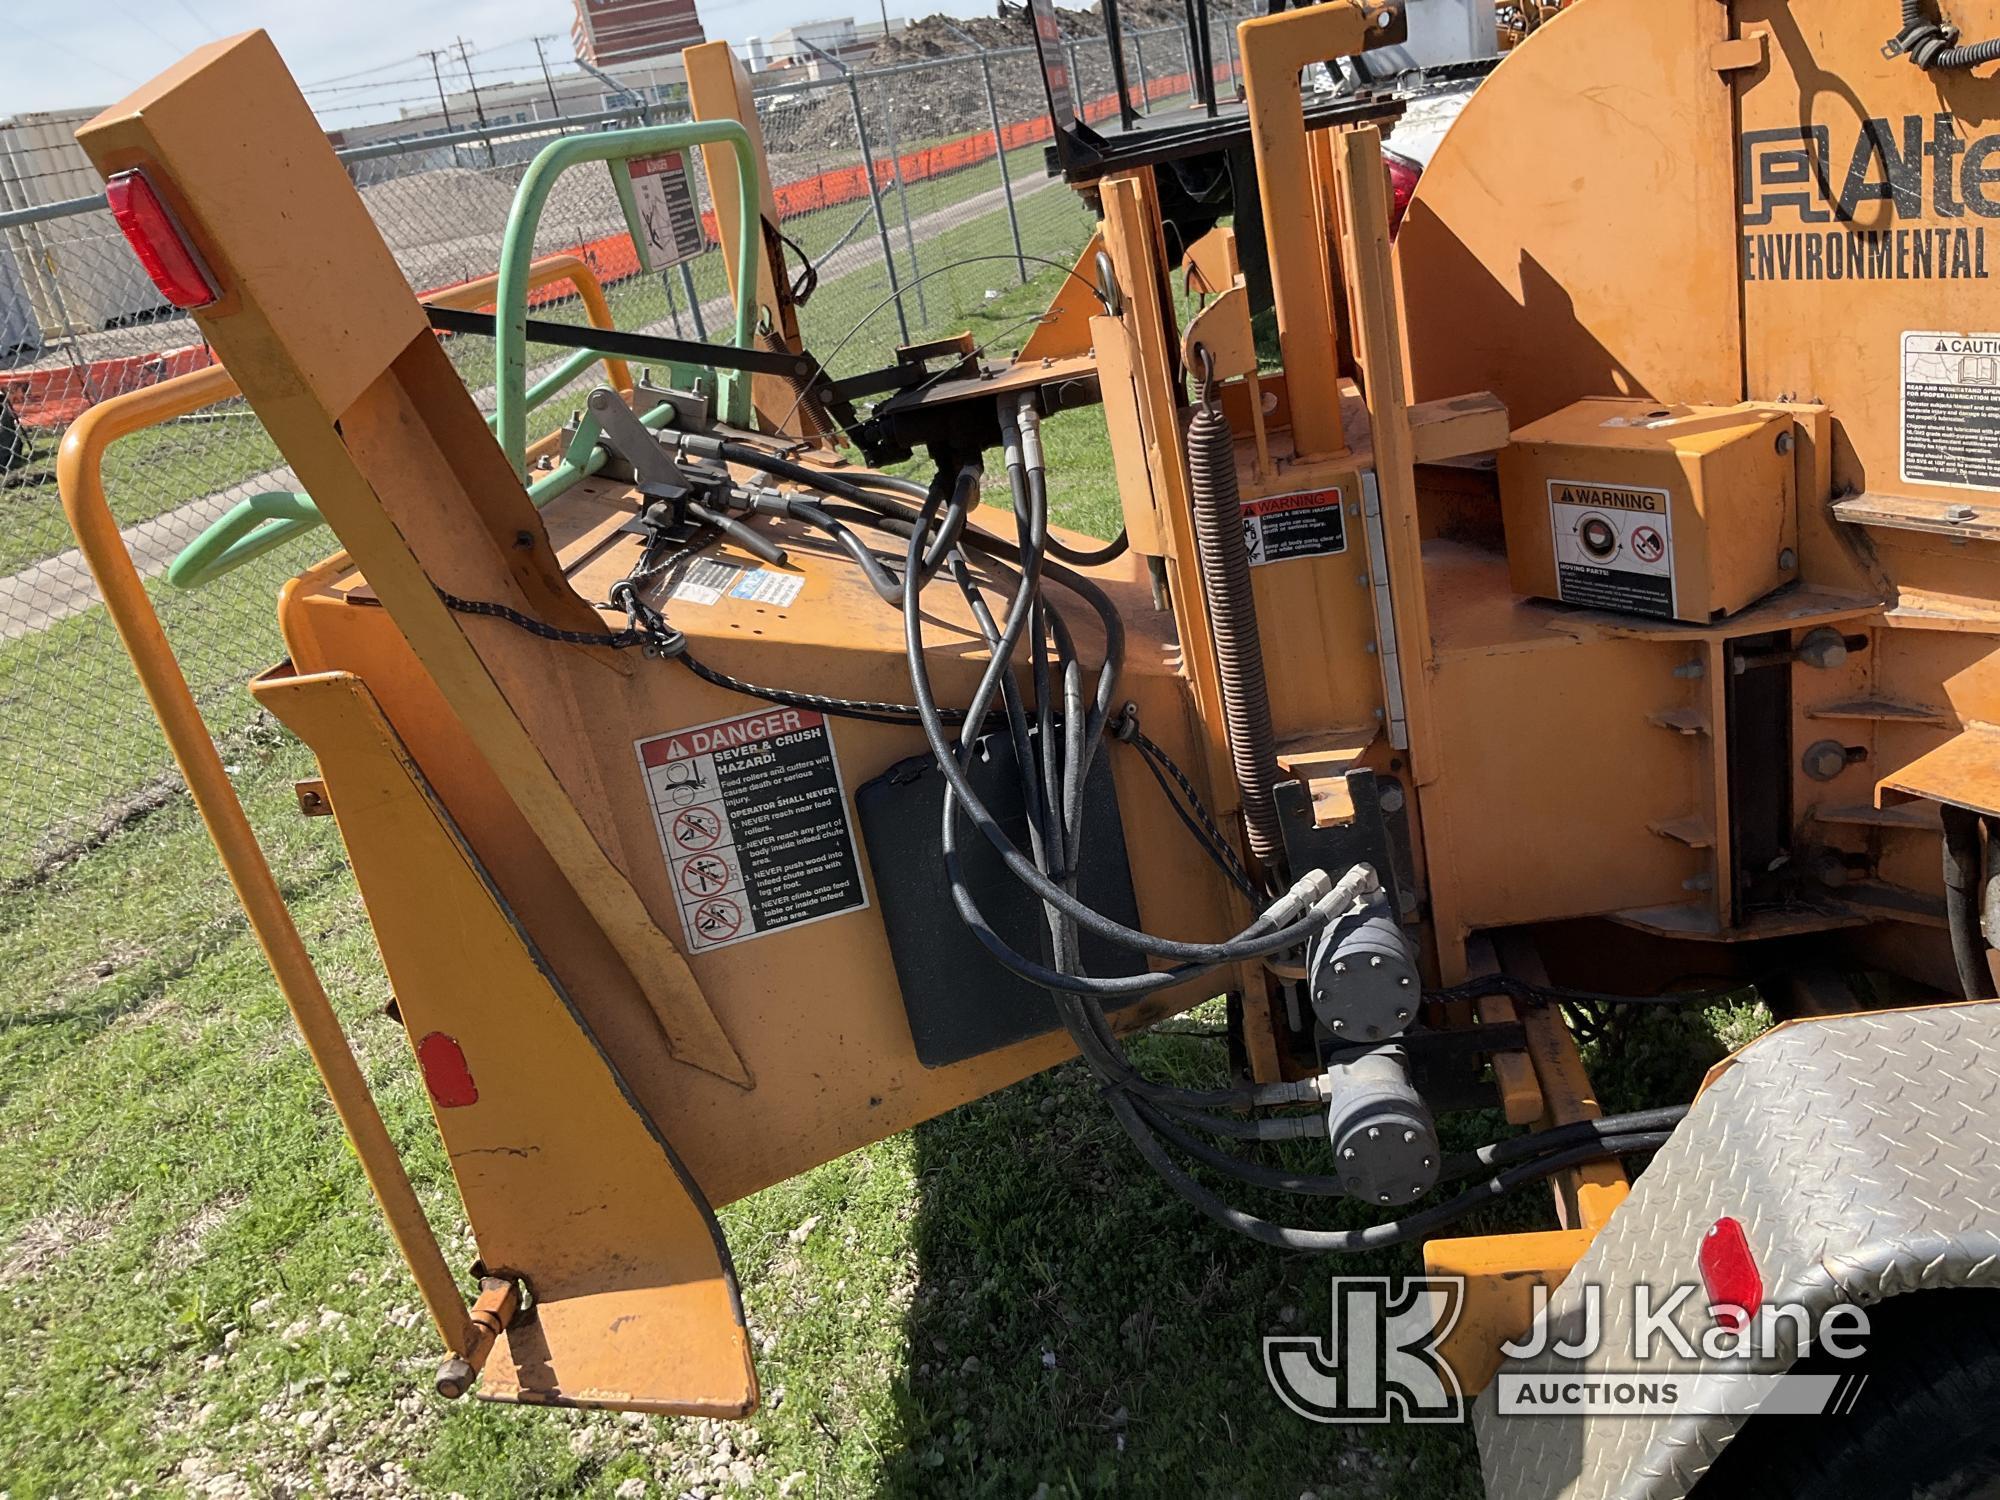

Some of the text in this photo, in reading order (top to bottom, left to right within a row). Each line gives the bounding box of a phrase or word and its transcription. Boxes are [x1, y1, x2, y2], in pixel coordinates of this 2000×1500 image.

[1744, 227, 1989, 281] ENVIRONMENTAL
[1951, 340, 2000, 353] CAUTI
[1258, 493, 1325, 512] WARNING
[1576, 489, 1655, 510] WARNING
[1560, 564, 1585, 572] MOVING
[692, 710, 801, 753] DANGER
[714, 727, 821, 762] SEVER & CRUSH
[717, 752, 776, 775] HAZARD!
[721, 755, 829, 788] Feed rollers and cutters will
[723, 770, 814, 797] cause death or serious
[725, 795, 750, 808] injury.
[730, 787, 837, 819] OPERATOR SHALL NEVER:
[741, 814, 770, 828] NEVER
[771, 809, 794, 819] reach
[796, 804, 813, 814] near
[814, 799, 832, 809] feed
[744, 826, 772, 837] rollers.
[746, 836, 775, 849] NEVER
[776, 830, 799, 841] reach
[800, 826, 814, 837] any
[816, 822, 832, 833] part
[833, 819, 842, 827] of
[749, 828, 844, 858] body inside infeed chute
[752, 858, 771, 867] area.
[754, 866, 783, 879] NEVER
[784, 861, 804, 873] push
[804, 855, 827, 867] wood
[827, 851, 843, 860] into
[757, 860, 842, 888] infeed chute area with
[759, 888, 772, 897] leg
[783, 880, 801, 891] foot.
[761, 896, 790, 909] NEVER
[791, 890, 813, 901] climb
[813, 885, 832, 895] onto
[832, 880, 850, 890] feed
[764, 890, 844, 917] table or inside infeed
[766, 910, 809, 926] chute area.
